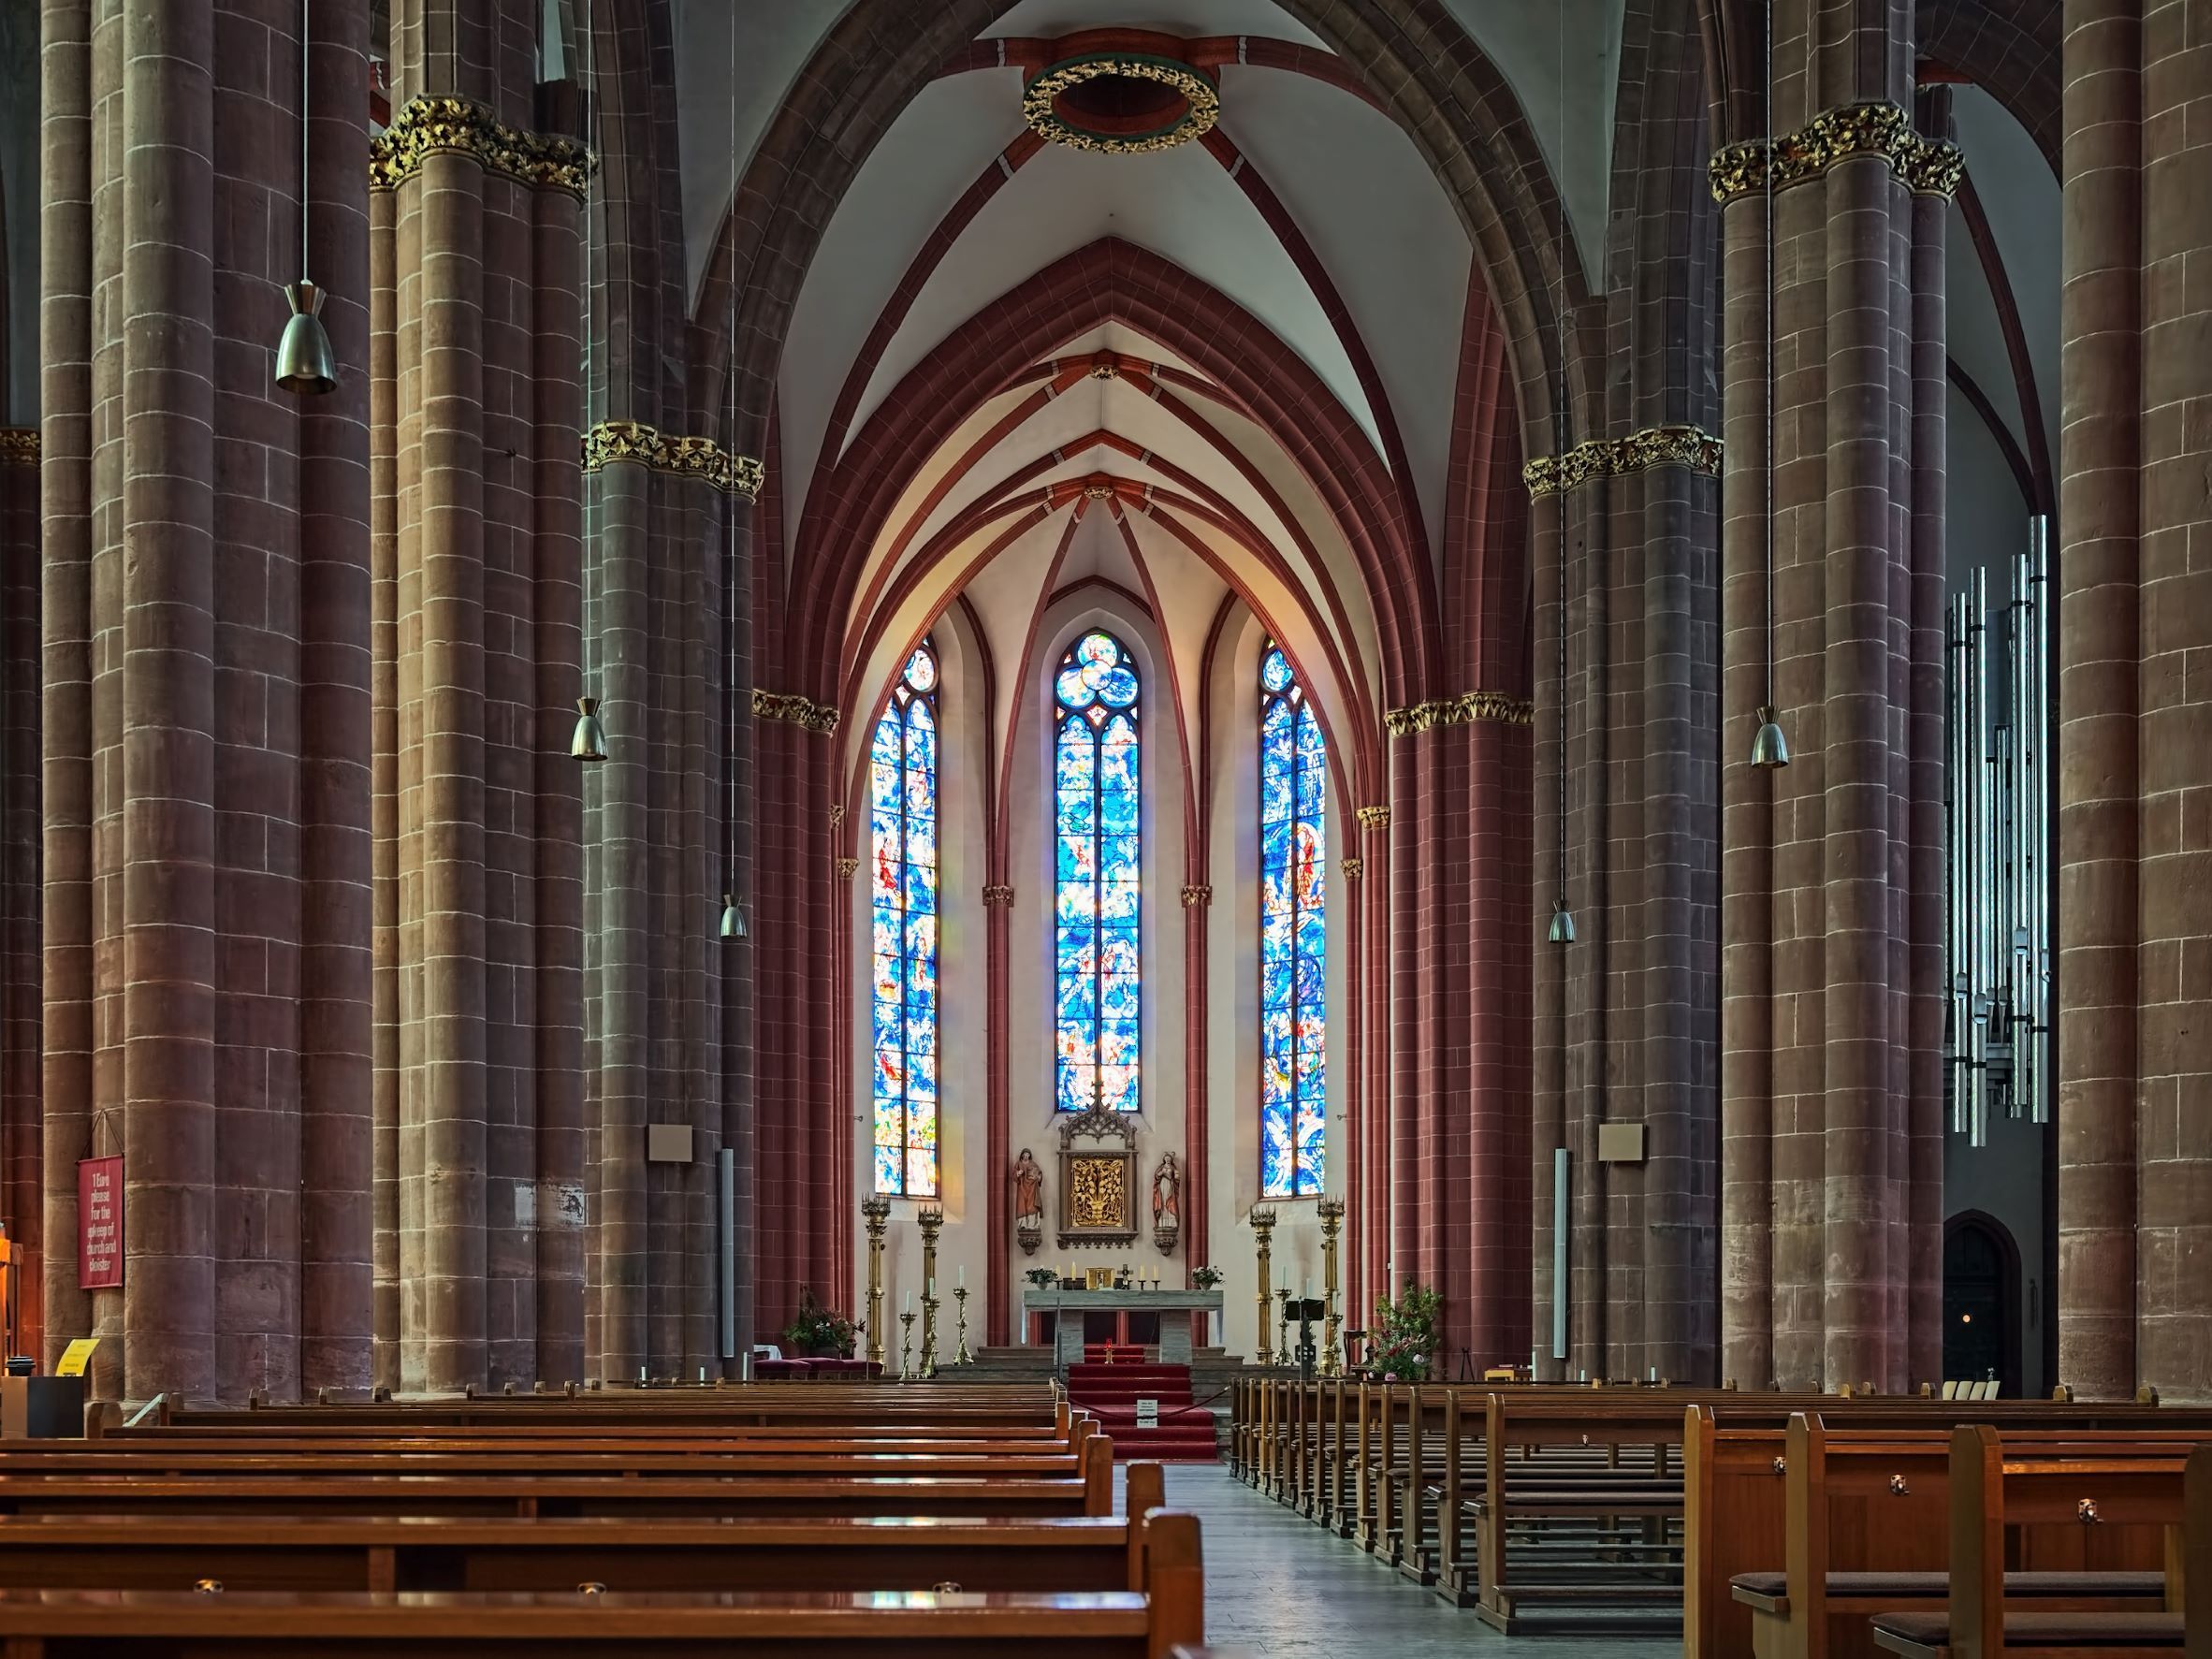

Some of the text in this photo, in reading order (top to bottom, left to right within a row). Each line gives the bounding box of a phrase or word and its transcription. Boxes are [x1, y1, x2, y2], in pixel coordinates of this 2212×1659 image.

[96, 1173, 110, 1187] Euro
[91, 1189, 110, 1205] please
[91, 1205, 110, 1220] for the
[87, 1222, 114, 1240] upkeep of
[86, 1239, 116, 1255] church and
[89, 1258, 111, 1272] cloister
